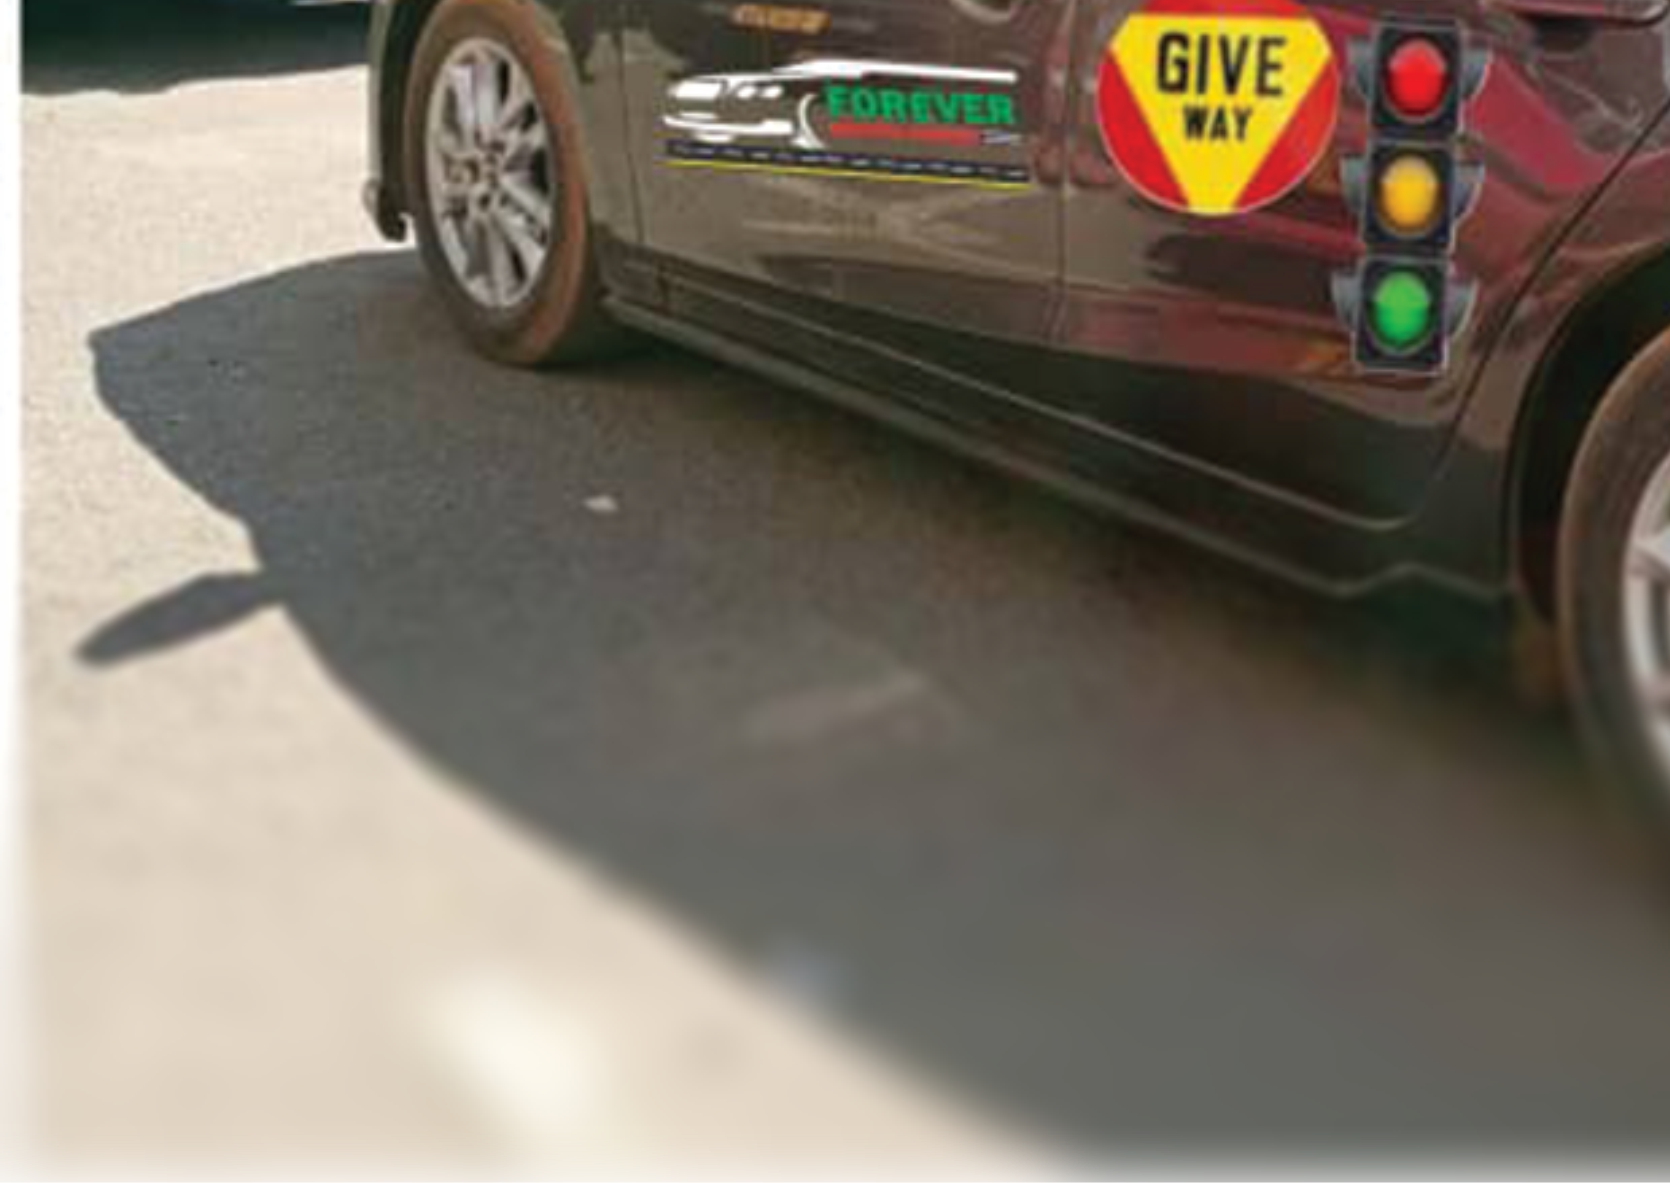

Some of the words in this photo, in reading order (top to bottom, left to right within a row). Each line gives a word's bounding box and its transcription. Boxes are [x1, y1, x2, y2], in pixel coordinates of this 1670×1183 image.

[1157, 30, 1286, 96] GIVE
[826, 87, 1014, 124] FOREVER
[1182, 105, 1253, 141] WAY
